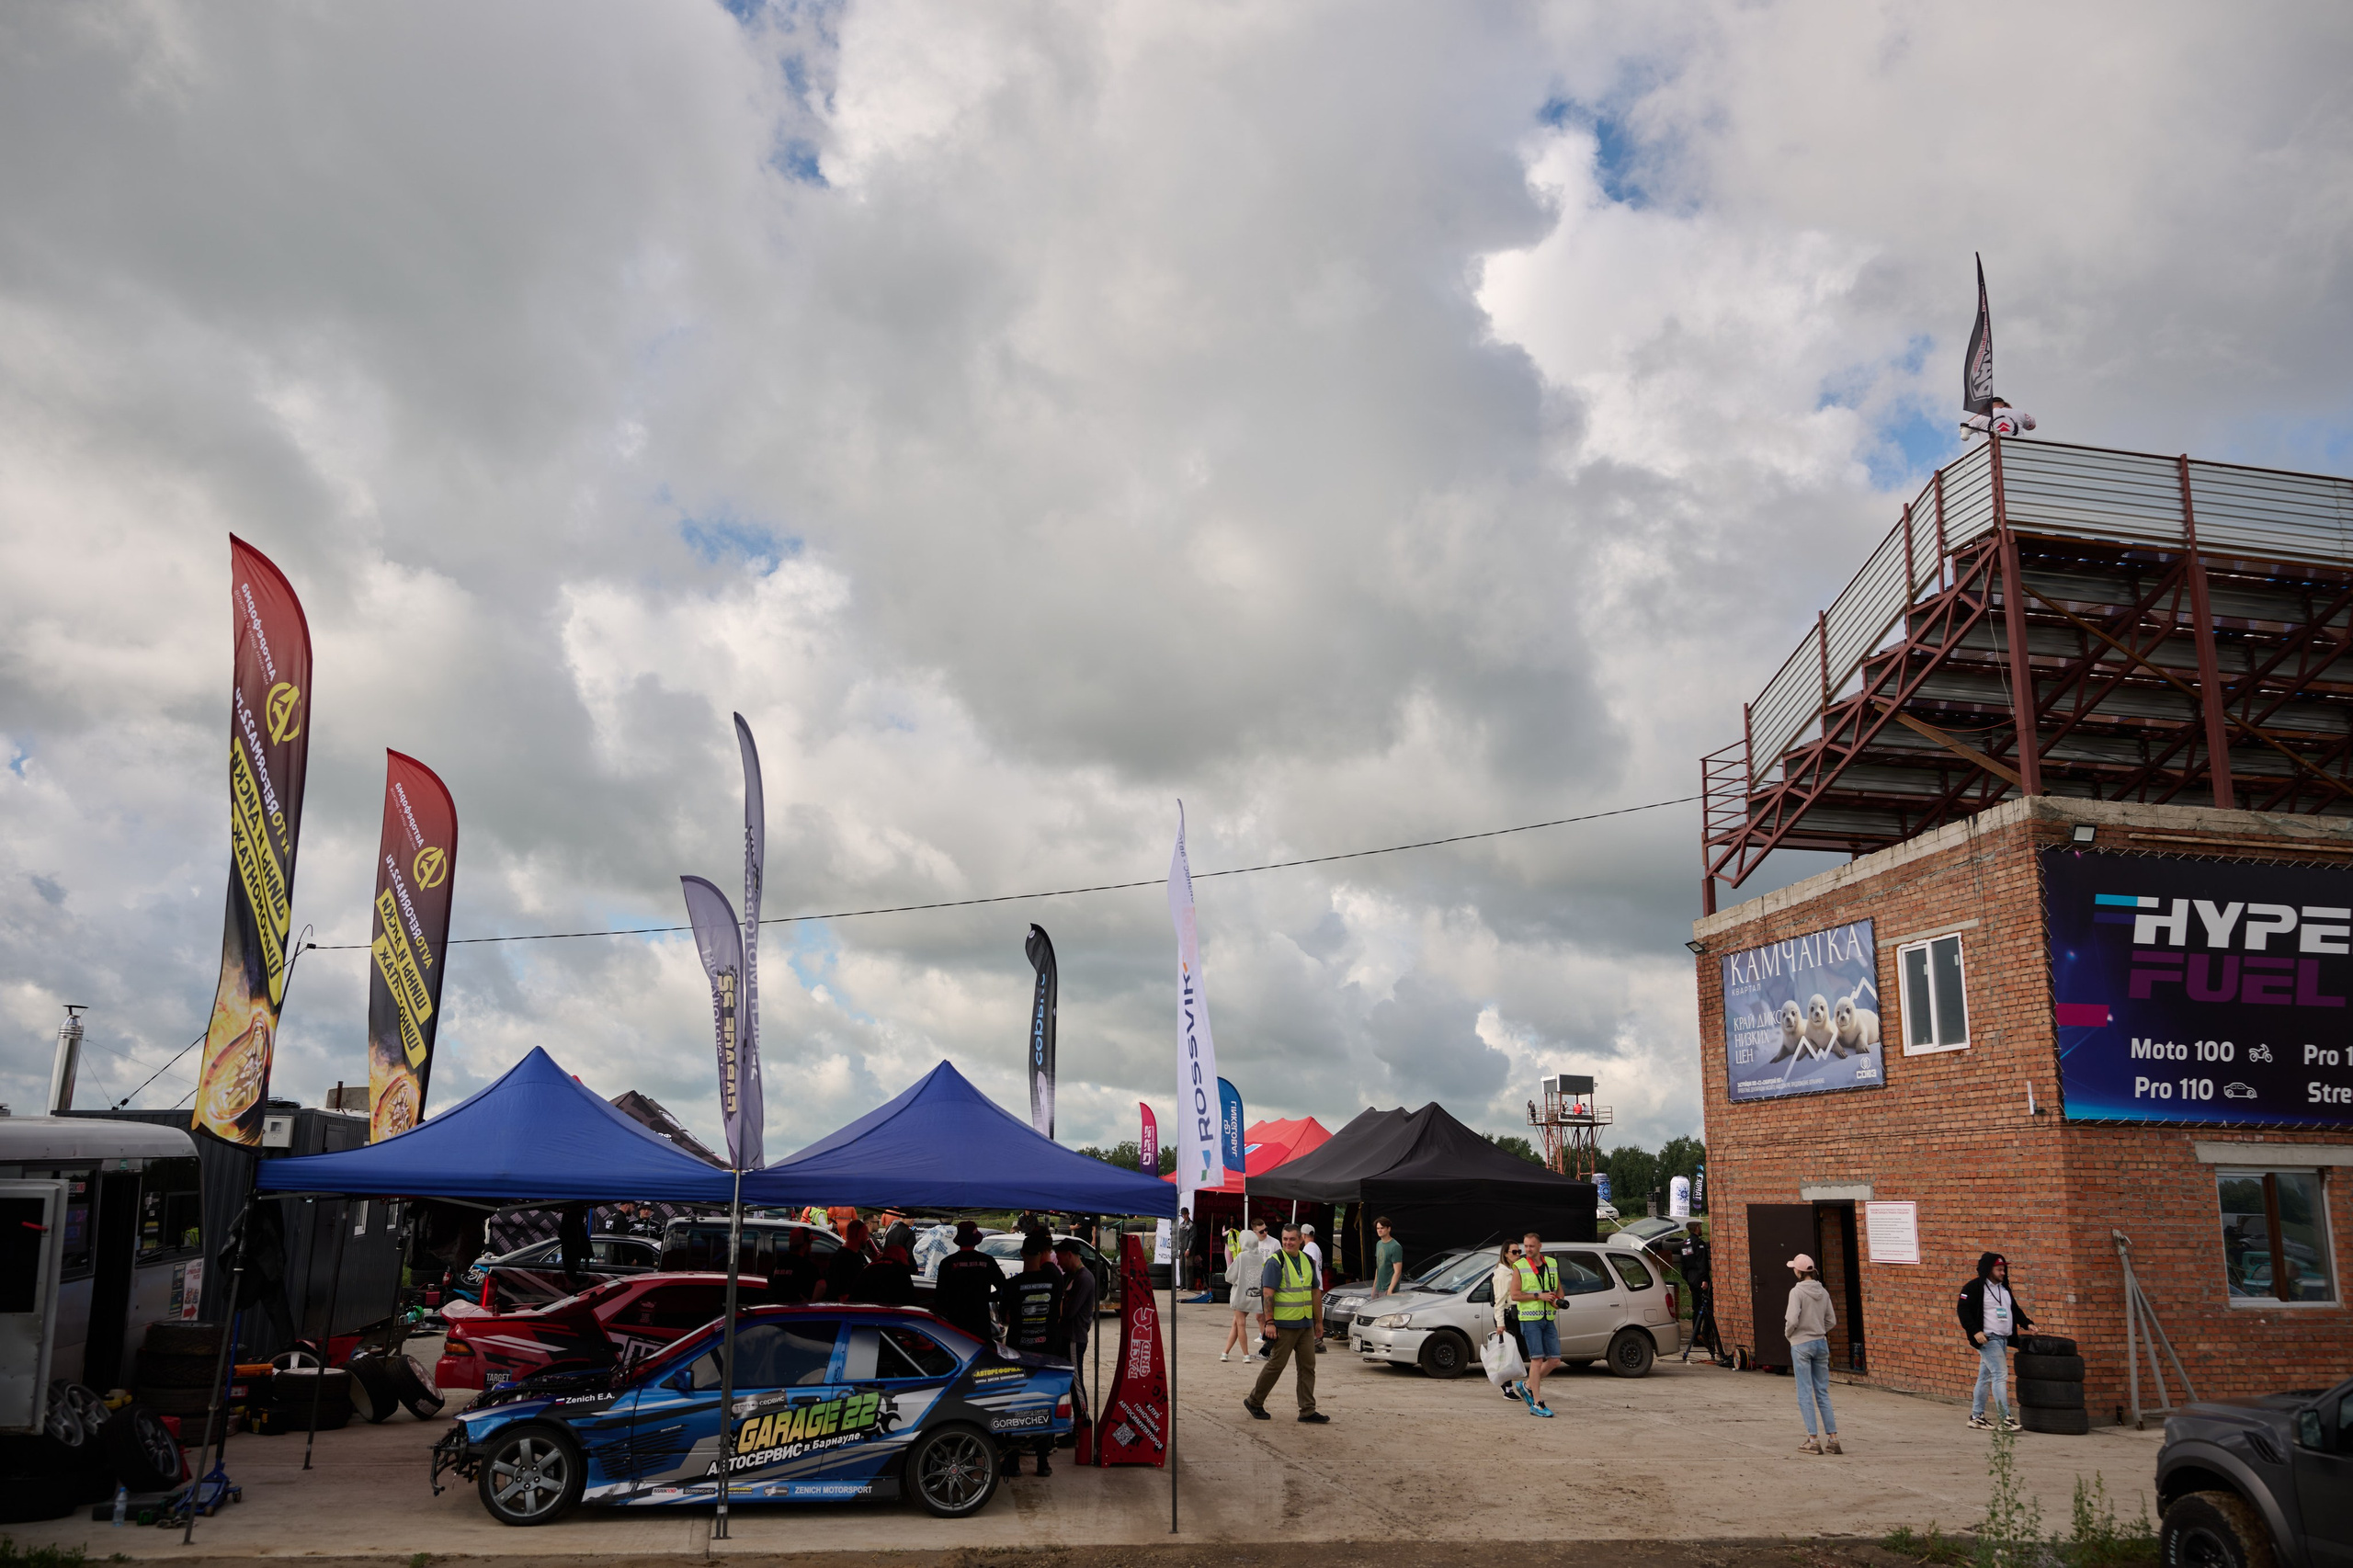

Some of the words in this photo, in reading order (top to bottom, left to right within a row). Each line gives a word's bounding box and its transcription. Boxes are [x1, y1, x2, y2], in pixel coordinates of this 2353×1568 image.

[1730, 924, 1863, 986] КАМЧАТКА
[1732, 983, 1761, 996] КВАРТАЛ
[2128, 950, 2347, 1007] FUEL
[1733, 1011, 1756, 1031] КРАЙ
[1734, 1028, 1770, 1048] НИЗКИХ
[1183, 968, 1213, 1142] ROSSVIK
[1735, 1049, 1754, 1064] ЦЕН
[2131, 1037, 2188, 1061] Moto
[2194, 1040, 2235, 1062] 100
[2303, 1044, 2339, 1066] Pro
[2134, 1076, 2173, 1099] Pro
[2179, 1077, 2214, 1100] 110
[1128, 1340, 1141, 1379] RACE
[1139, 1340, 1152, 1378] GRID
[486, 1373, 510, 1382] TARGET
[565, 1393, 596, 1404] Zenich
[597, 1392, 615, 1402] E.A.
[759, 1395, 785, 1406] сервис
[1133, 1403, 1161, 1433] ГОНОЧНЫХ
[1145, 1403, 1161, 1420] КЛУБ
[737, 1399, 843, 1454] GARAGE
[840, 1392, 880, 1431] 22
[1118, 1400, 1164, 1450] АВТОСИМУЛЯТОРОВ
[803, 1444, 809, 1452] в
[813, 1431, 861, 1449] Барнауле
[795, 1486, 822, 1494] ZENICH
[822, 1485, 872, 1494] MOTORSPORT
